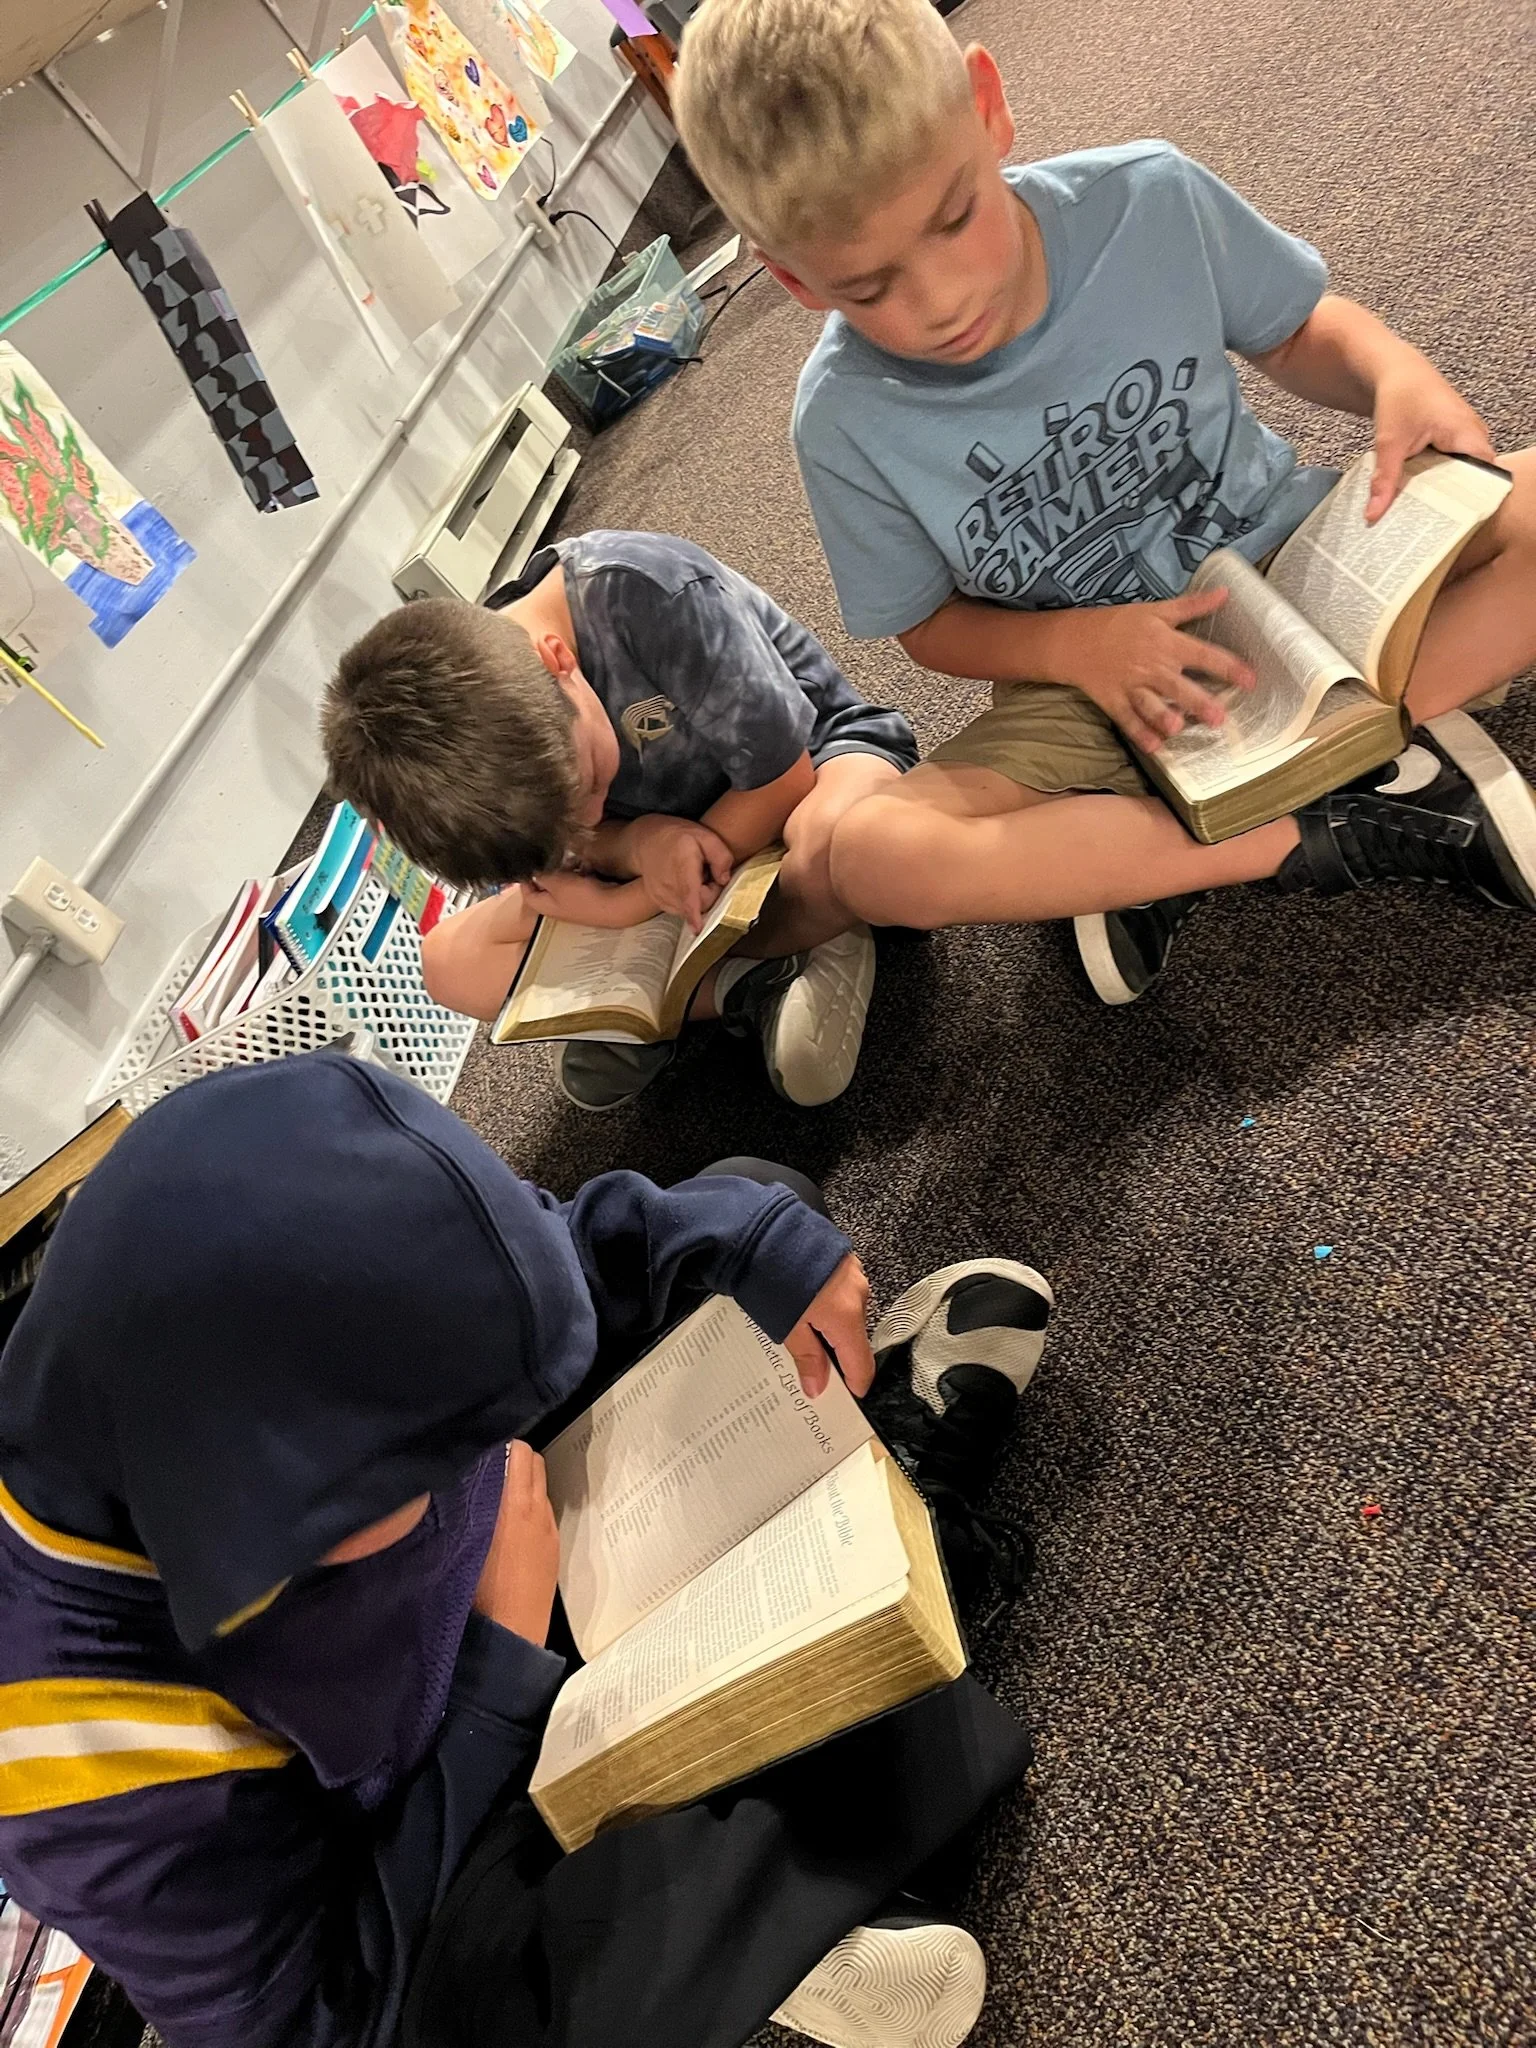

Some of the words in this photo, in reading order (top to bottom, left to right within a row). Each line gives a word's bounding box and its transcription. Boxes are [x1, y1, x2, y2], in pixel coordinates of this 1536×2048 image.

[955, 358, 1162, 573] RETRO
[974, 398, 1192, 599] GAMER
[778, 1373, 802, 1397] List
[794, 1398, 809, 1412] of
[803, 1410, 834, 1455] Books
[831, 1499, 845, 1517] the
[835, 1515, 855, 1546] Bible
